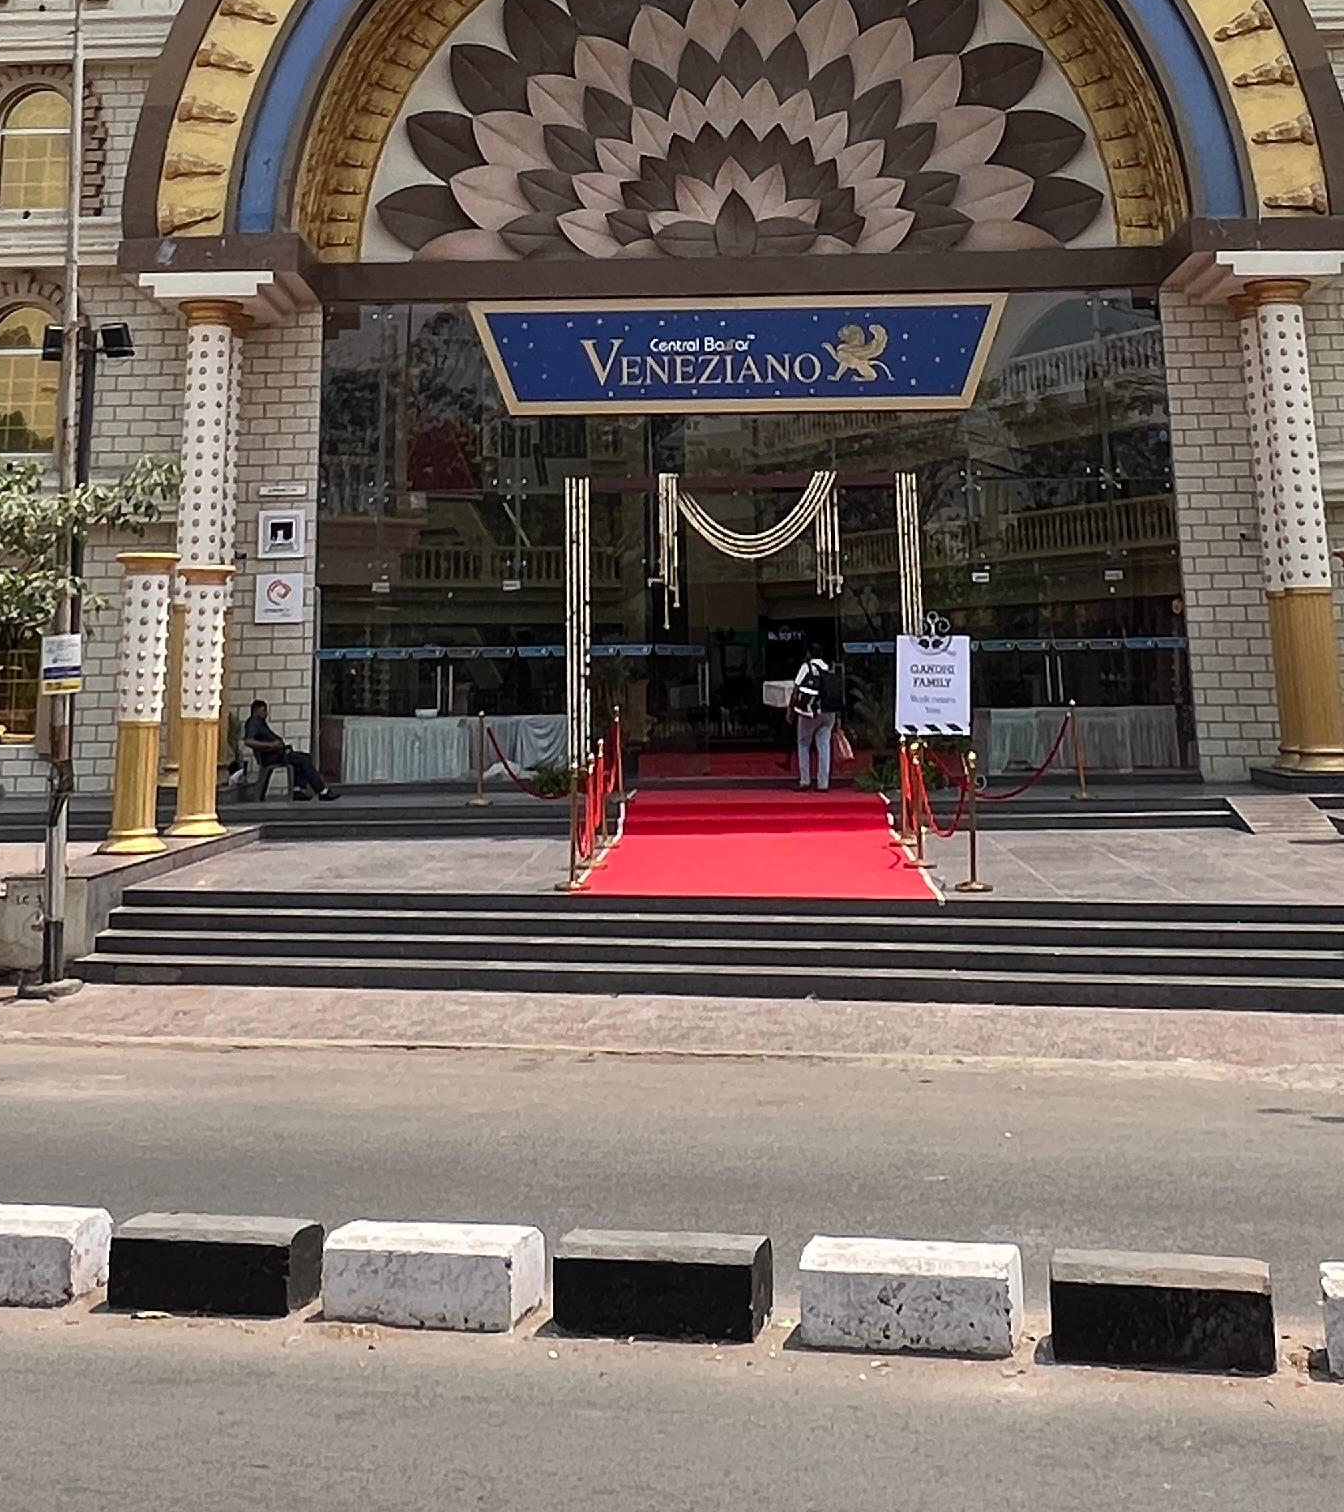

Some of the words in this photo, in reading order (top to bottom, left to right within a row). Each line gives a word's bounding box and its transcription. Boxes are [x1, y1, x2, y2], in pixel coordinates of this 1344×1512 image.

[650, 337, 700, 352] Central
[579, 338, 822, 386] VENEZIANO
[913, 677, 952, 688] FAMILY
